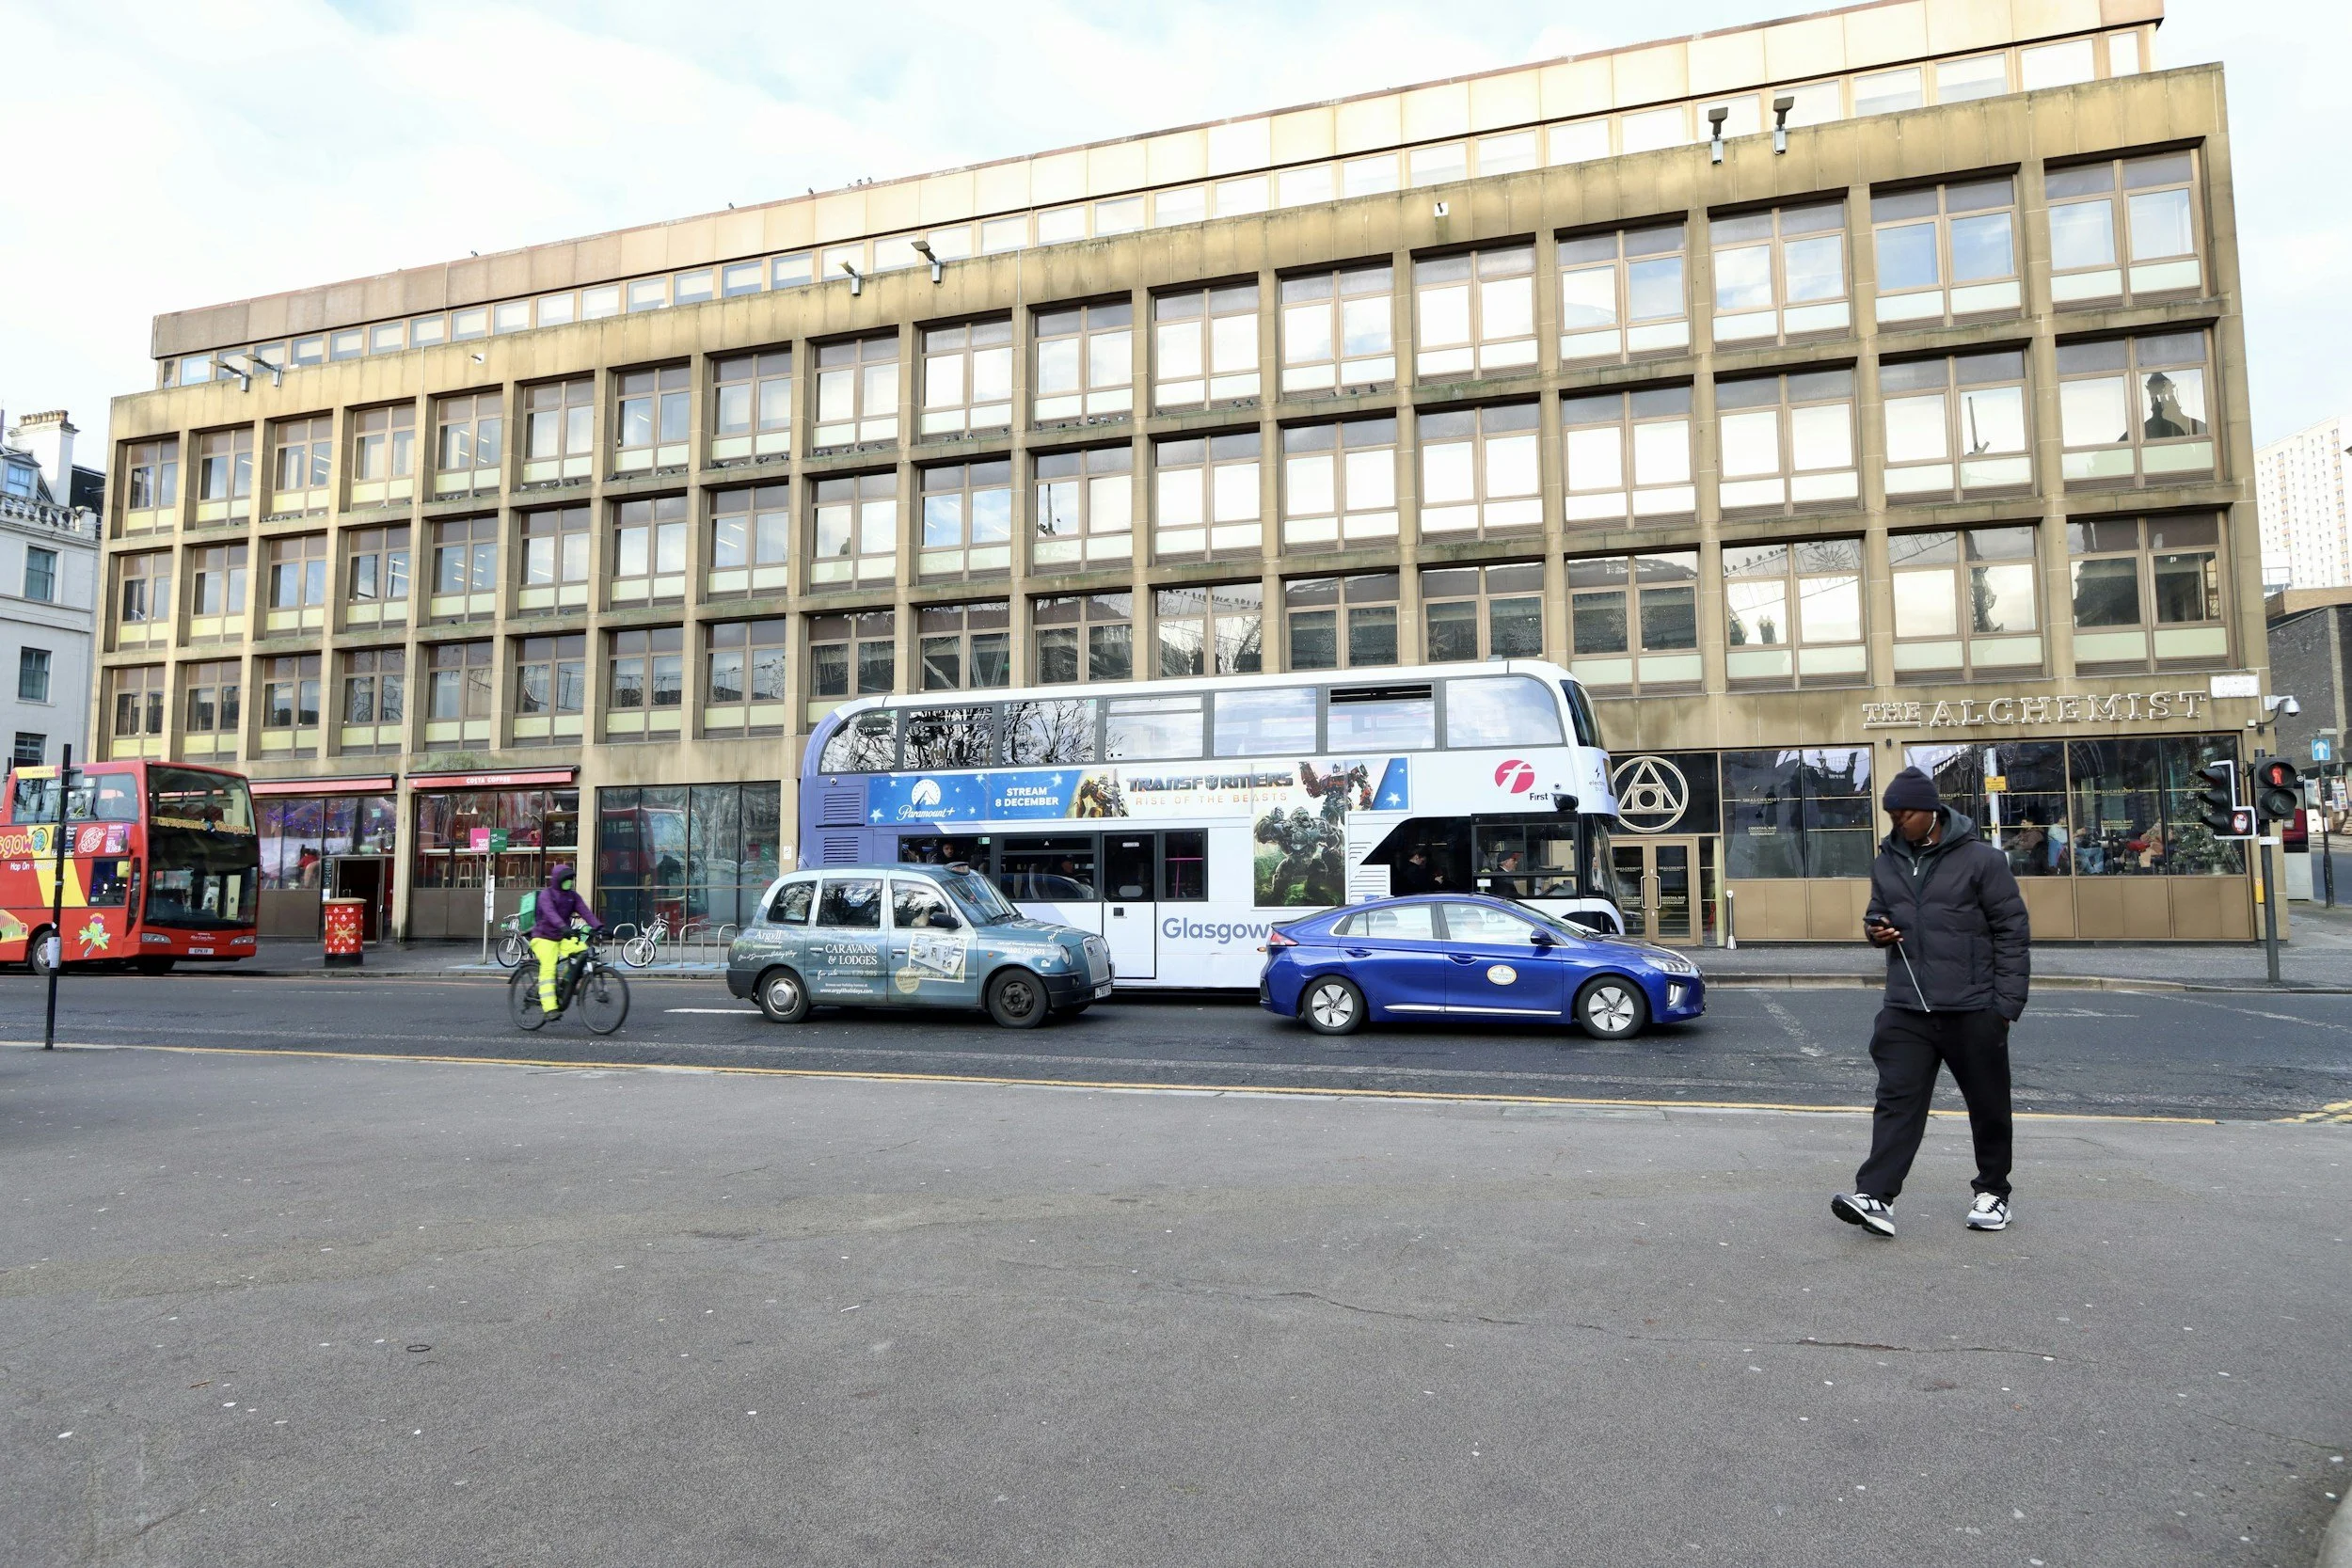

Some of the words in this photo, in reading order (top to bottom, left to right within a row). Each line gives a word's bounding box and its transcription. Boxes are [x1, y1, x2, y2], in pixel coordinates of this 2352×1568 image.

[1863, 703, 1920, 721] THE
[1930, 690, 2207, 726] ALCHEMIST
[1007, 787, 1047, 797] STREAM
[995, 799, 1001, 807] 8
[1004, 798, 1059, 807] DECEMBER
[1136, 797, 1166, 805] RISE
[1175, 796, 1190, 804] OF
[1200, 795, 1224, 804] THE
[1233, 793, 1287, 803] BEASTS
[896, 805, 956, 821] Paramount+
[10, 862, 19, 871] Hop
[22, 860, 29, 870] On
[754, 929, 783, 941] Argyll
[1162, 917, 1270, 944] Glasgow
[825, 943, 878, 954] CARAVANS
[828, 955, 837, 965] &
[839, 955, 878, 965] LODGES
